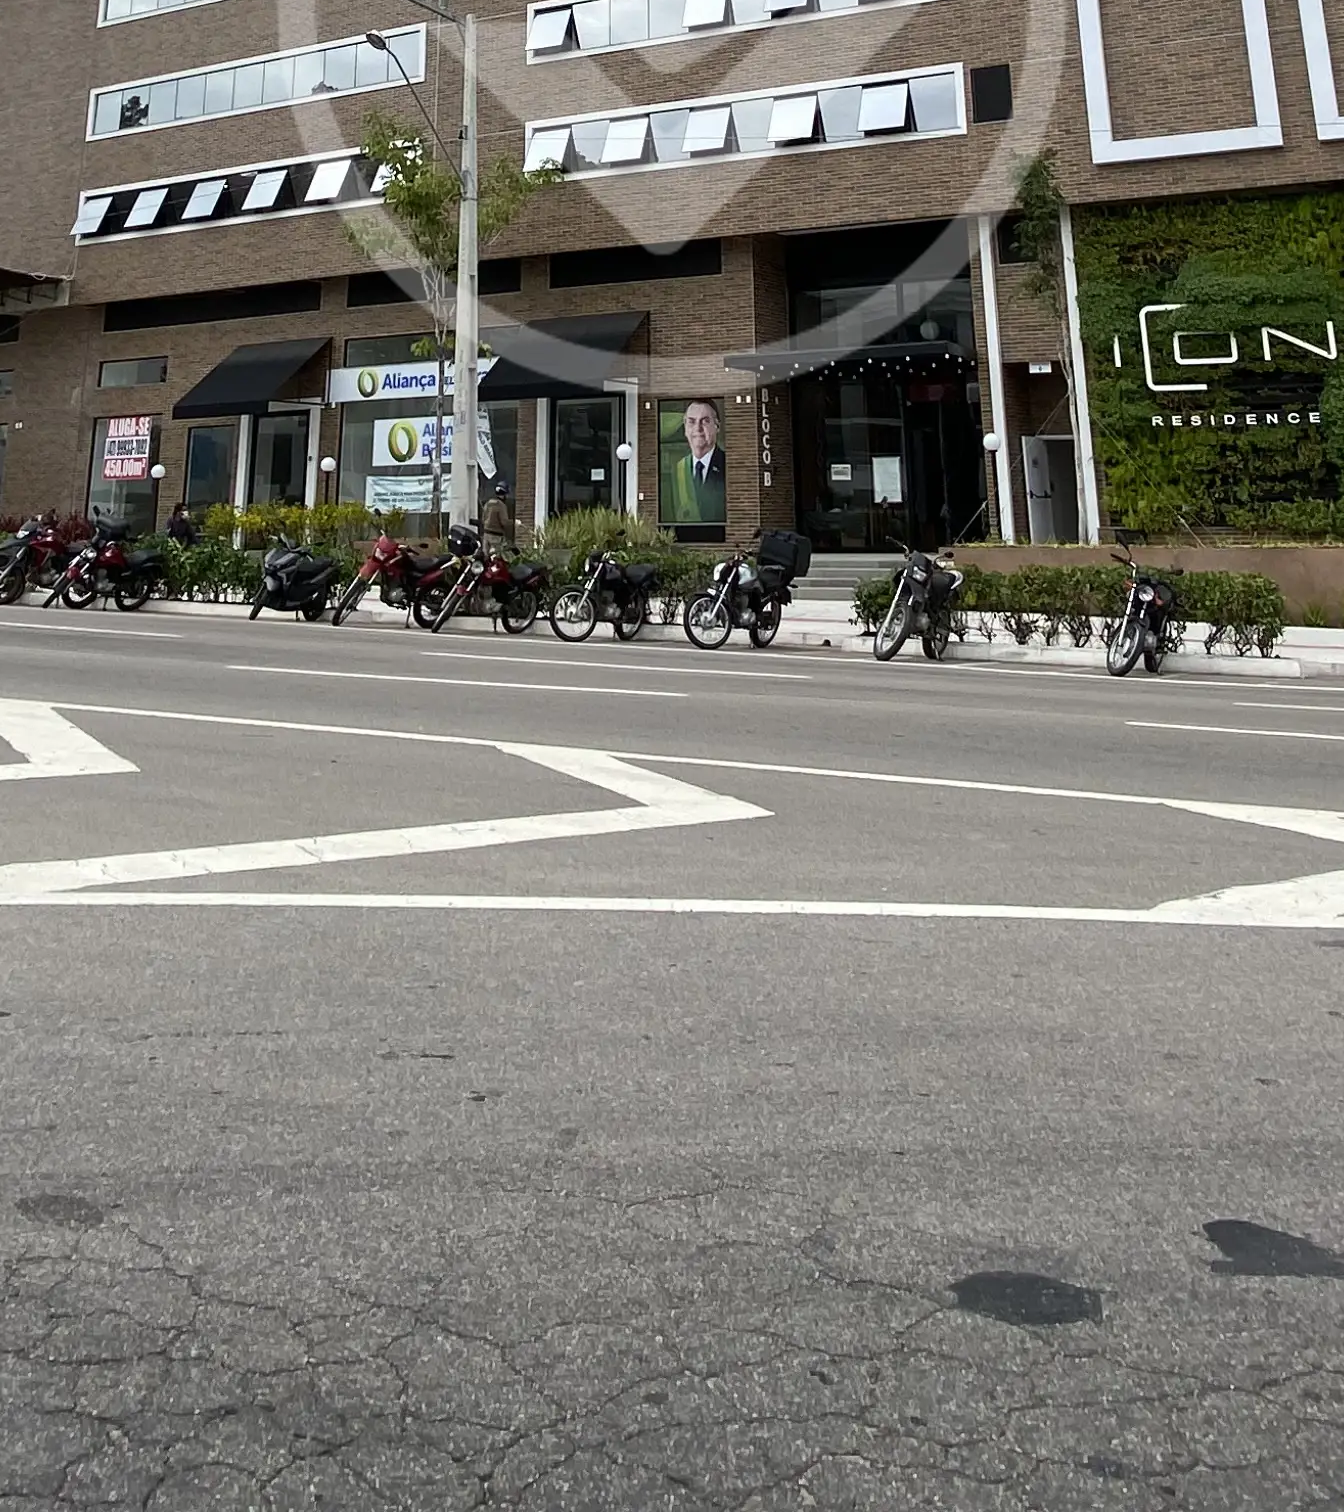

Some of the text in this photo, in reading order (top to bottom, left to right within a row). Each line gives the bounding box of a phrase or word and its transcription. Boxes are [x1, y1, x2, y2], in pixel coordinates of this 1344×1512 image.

[382, 372, 436, 392] Aliança
[108, 417, 150, 437] ALUGA-SE
[1151, 412, 1321, 427] RESIDENCE
[761, 388, 772, 486] BLOCO B
